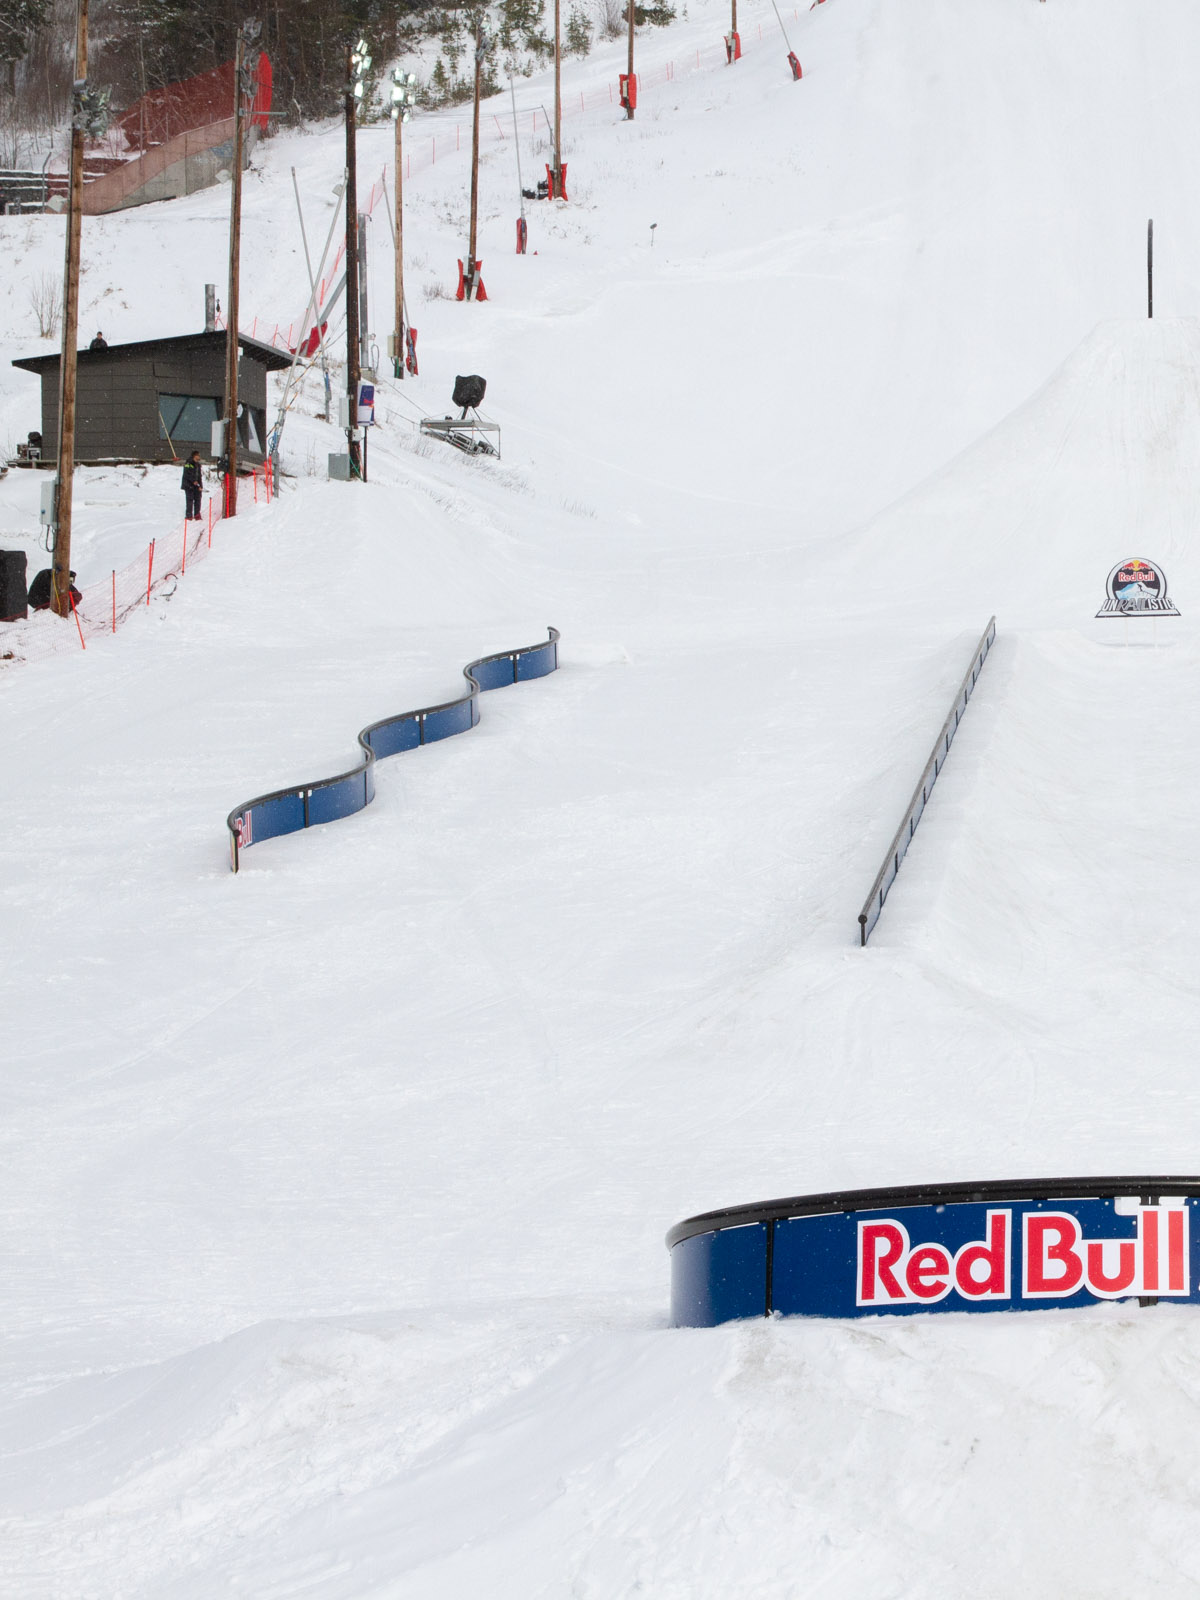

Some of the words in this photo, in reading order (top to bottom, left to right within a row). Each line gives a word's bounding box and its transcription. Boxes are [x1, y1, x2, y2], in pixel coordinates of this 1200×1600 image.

[1118, 572, 1136, 582] Red
[1137, 571, 1155, 582] Bull
[1102, 597, 1175, 612] UNRAILISTIC
[857, 1209, 1011, 1305] Red
[1023, 1206, 1189, 1298] Bull
